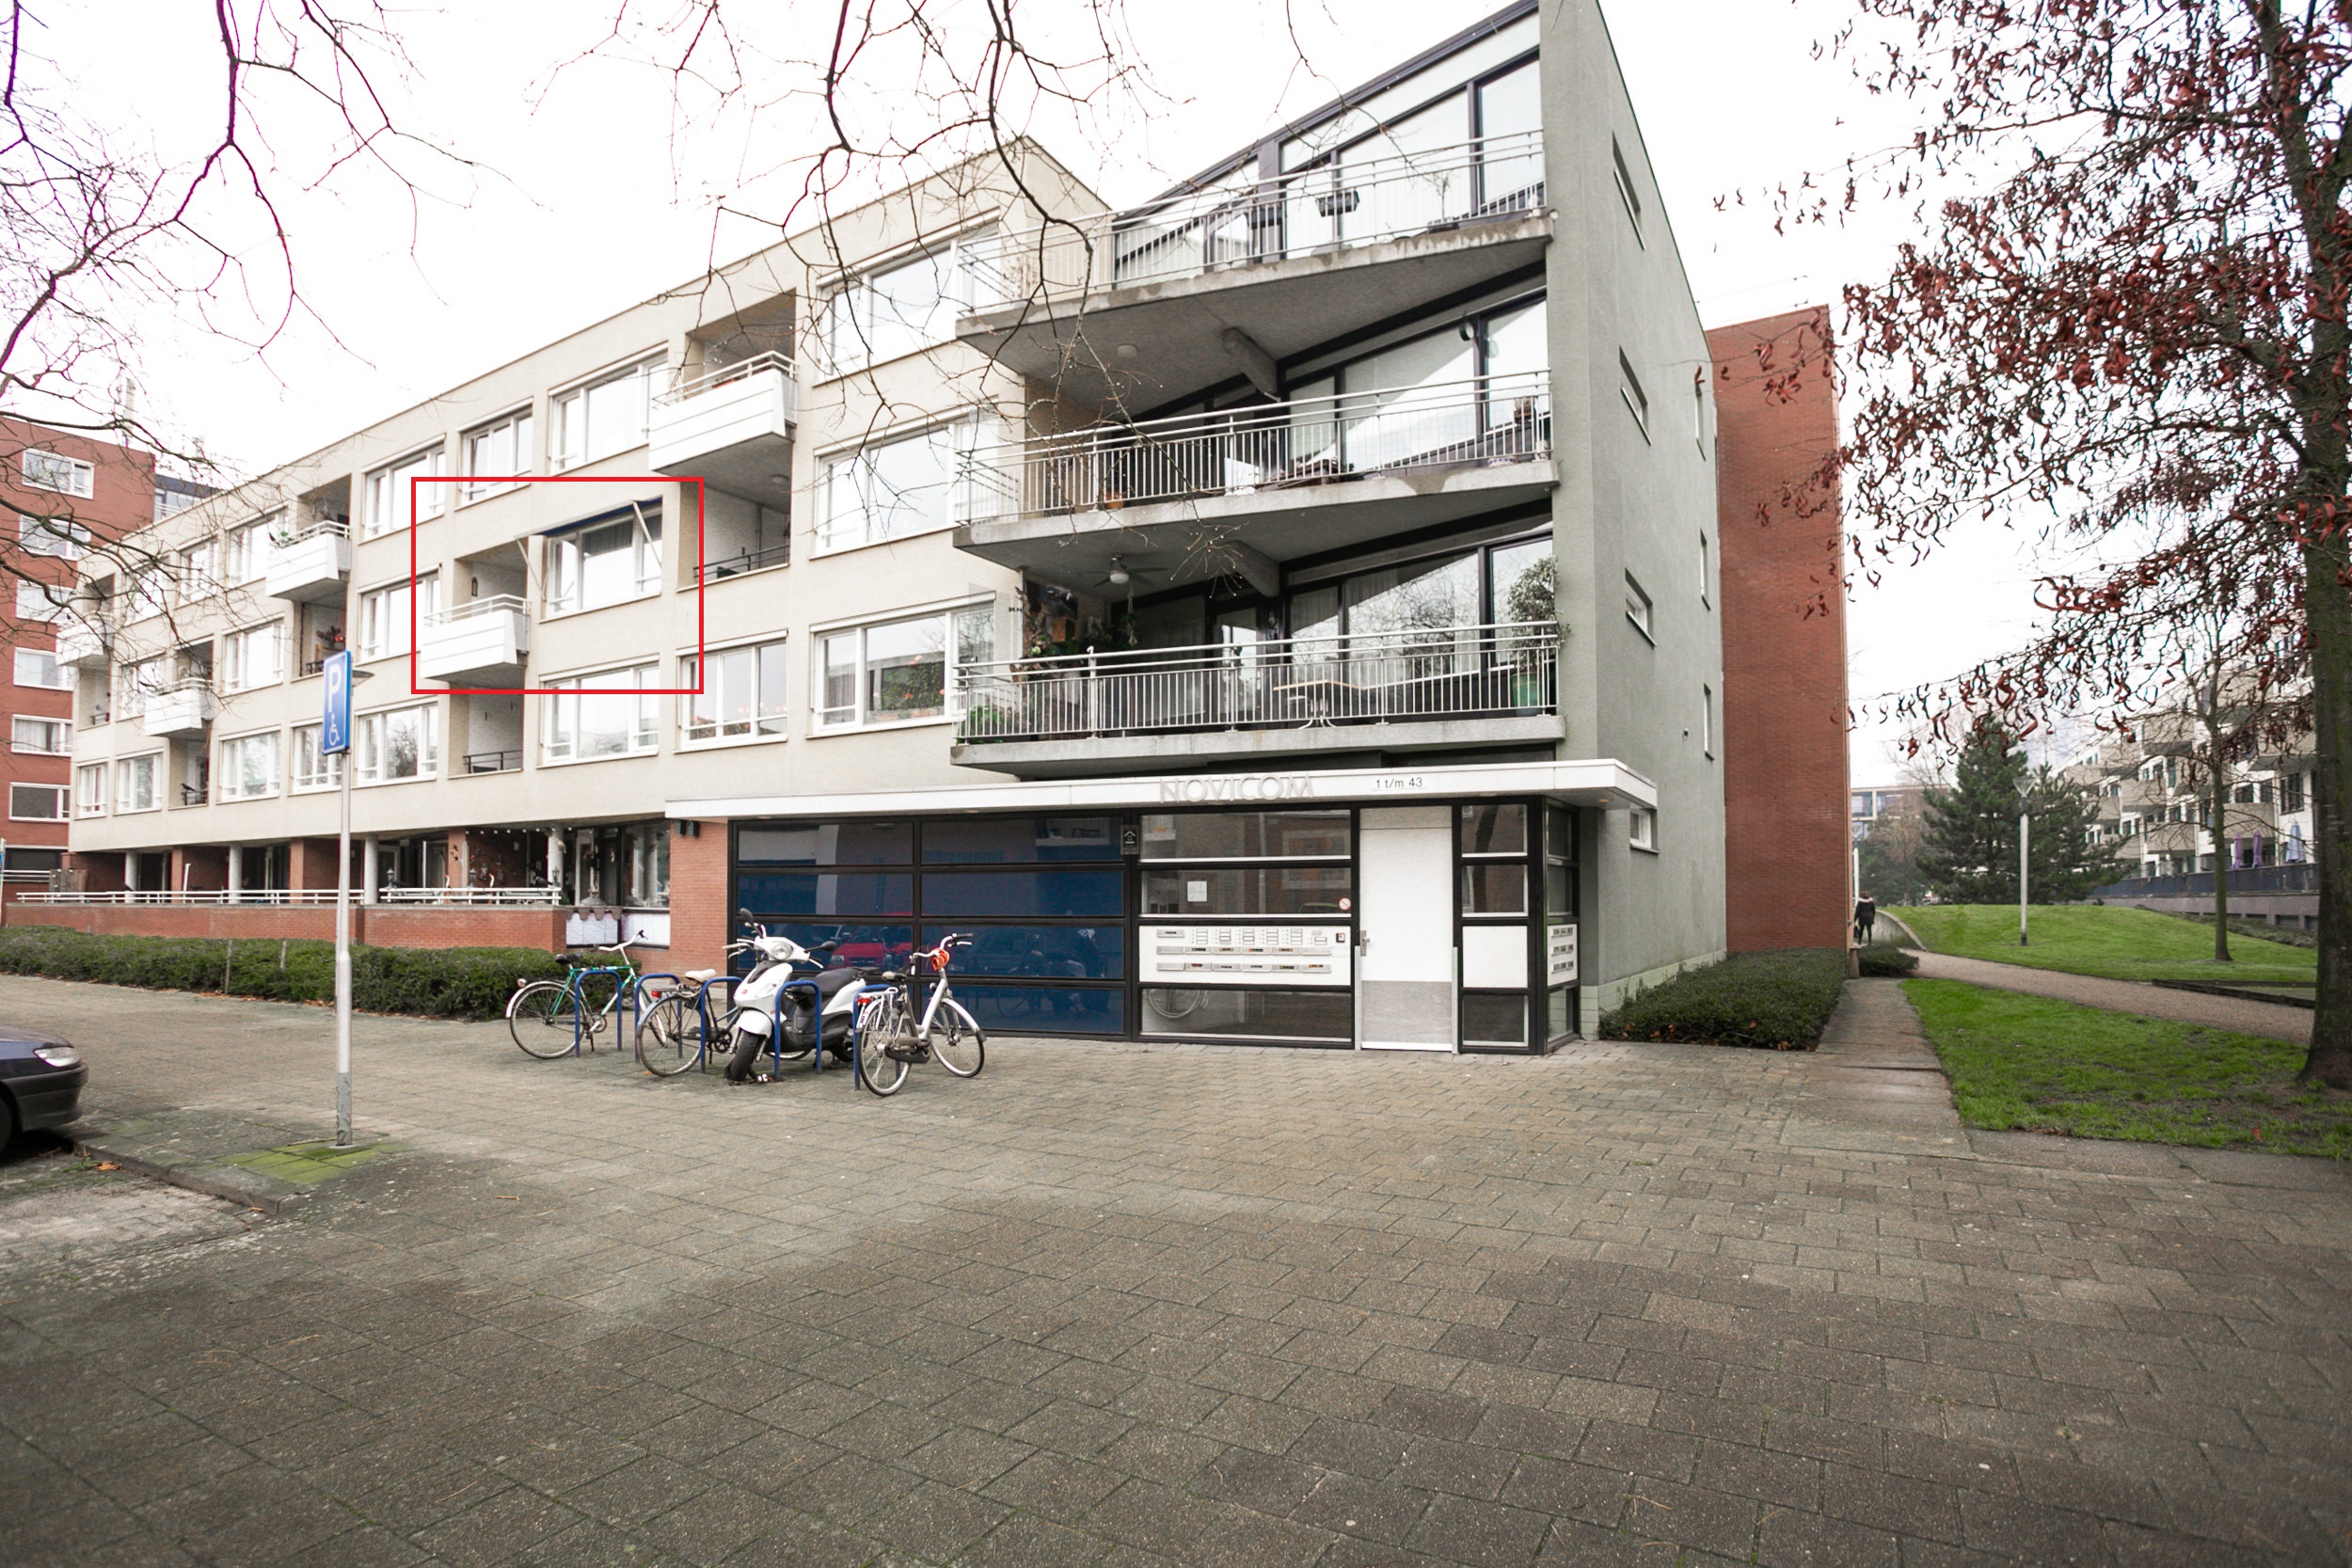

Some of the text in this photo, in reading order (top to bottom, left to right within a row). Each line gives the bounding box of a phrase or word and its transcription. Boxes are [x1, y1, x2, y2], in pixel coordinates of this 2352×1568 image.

[328, 663, 342, 713] P
[1160, 772, 1314, 803] NOVICOM
[1375, 777, 1422, 788] 1 t/m 43
